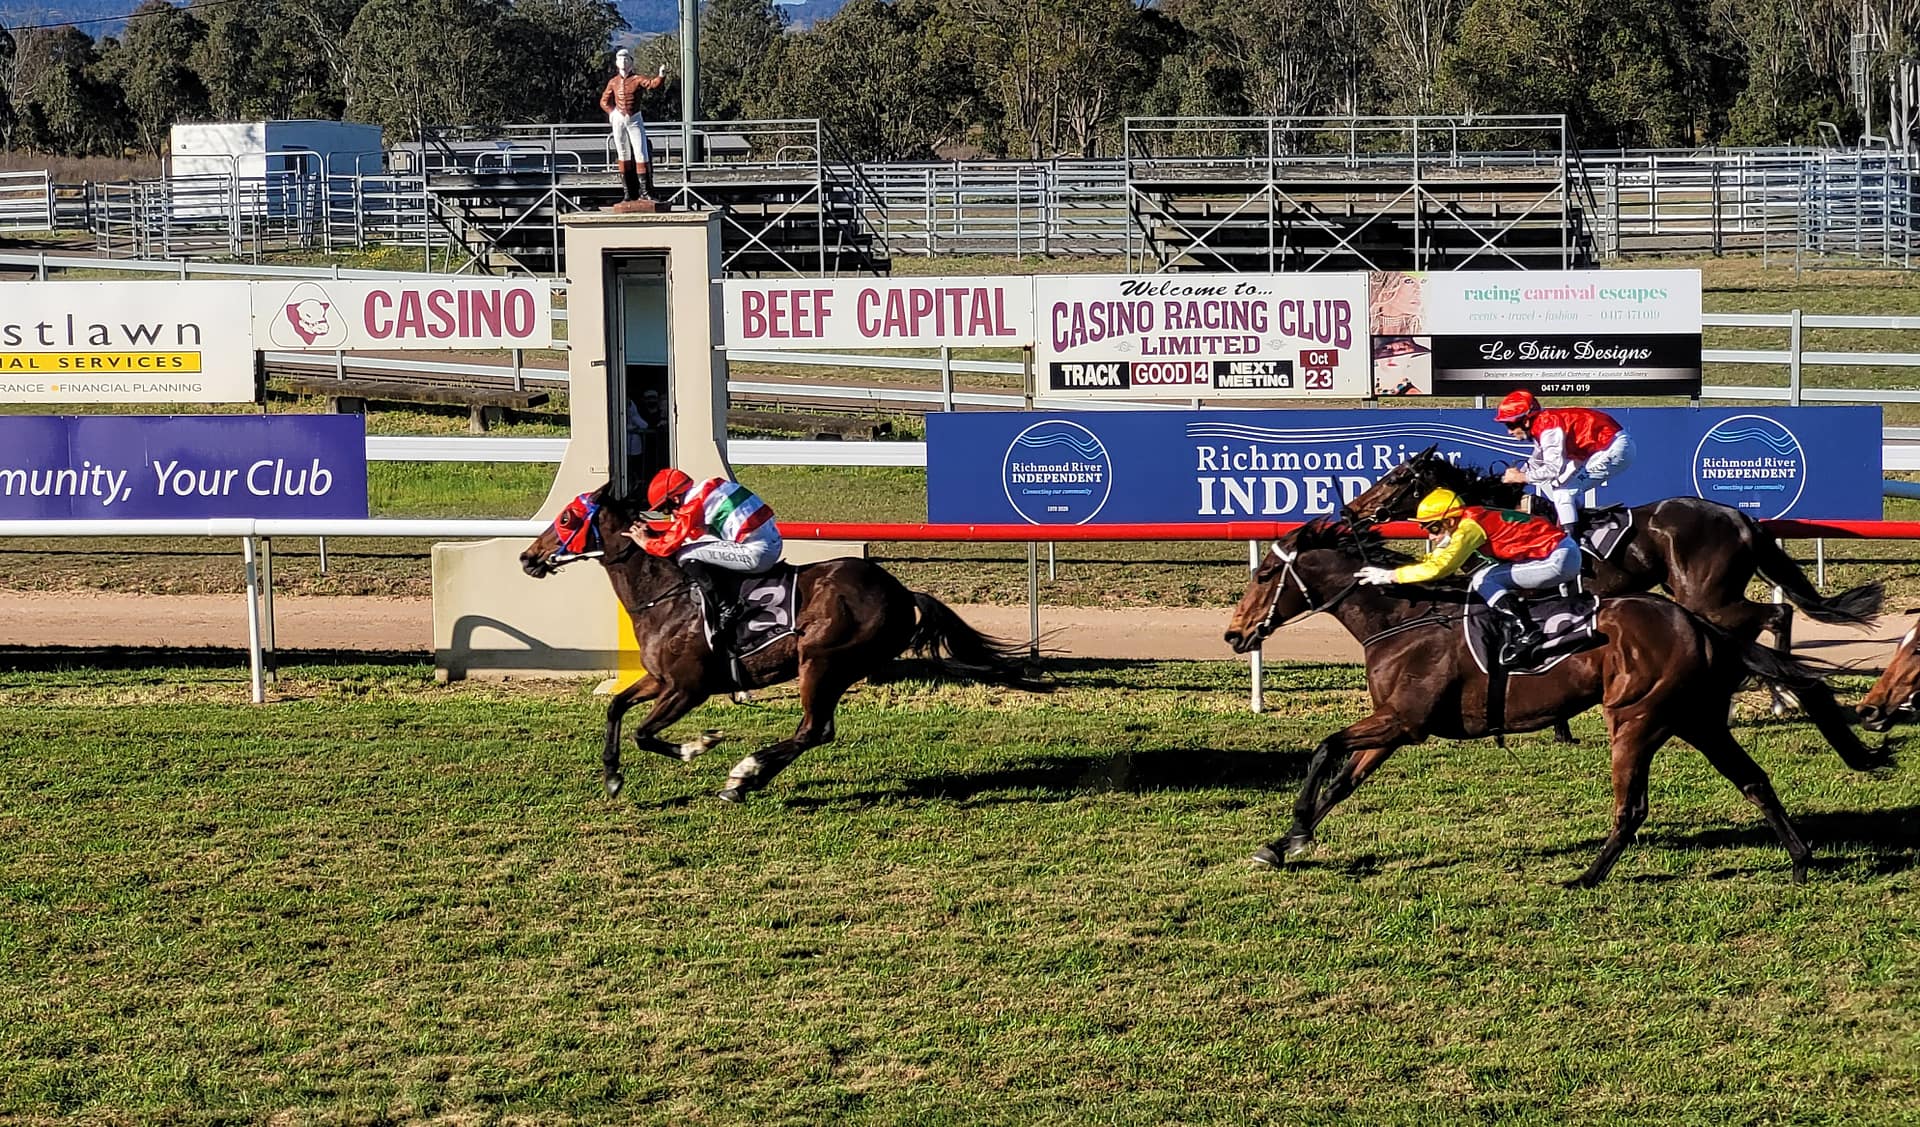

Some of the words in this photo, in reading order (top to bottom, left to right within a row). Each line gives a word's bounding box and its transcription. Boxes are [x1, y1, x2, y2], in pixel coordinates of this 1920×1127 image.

[1119, 280, 1227, 297] Welcome
[1464, 285, 1520, 303] racing
[1524, 284, 1596, 301] carnival
[1599, 286, 1667, 303] escapes
[364, 288, 535, 339] CASINO
[742, 289, 834, 339] BEEF
[857, 287, 1017, 338] CAPITAL
[1052, 300, 1155, 353] CASINO
[1164, 300, 1268, 333] RACING
[1279, 299, 1352, 350] CLUB
[1141, 335, 1261, 356] LIMITED
[1479, 340, 1516, 361] Le
[1573, 340, 1652, 366] Designs
[58, 356, 183, 369] SERVICES
[1309, 351, 1330, 366] Oct
[1061, 363, 1122, 387] TRACK
[1134, 364, 1188, 384] GOOD
[1194, 364, 1209, 383] 4
[1230, 361, 1278, 375] NEXT
[1218, 374, 1289, 388] MEETING
[1306, 369, 1333, 388] 23
[60, 383, 130, 393] FINANCIAL
[133, 383, 202, 393] PLANNING
[1541, 384, 1560, 392] 0417
[1560, 384, 1574, 392] 471
[1576, 384, 1591, 392] 019
[1196, 444, 1365, 471] Richmond
[1703, 457, 1762, 468] Richmond
[1764, 457, 1796, 468] River
[1012, 462, 1069, 473] Richmond
[1071, 462, 1102, 472] River
[1702, 468, 1797, 479] INDEPENDENT
[153, 460, 239, 497] Your
[247, 459, 333, 497] Club
[1012, 473, 1103, 483] INDEPENDENT
[748, 585, 788, 632] 3
